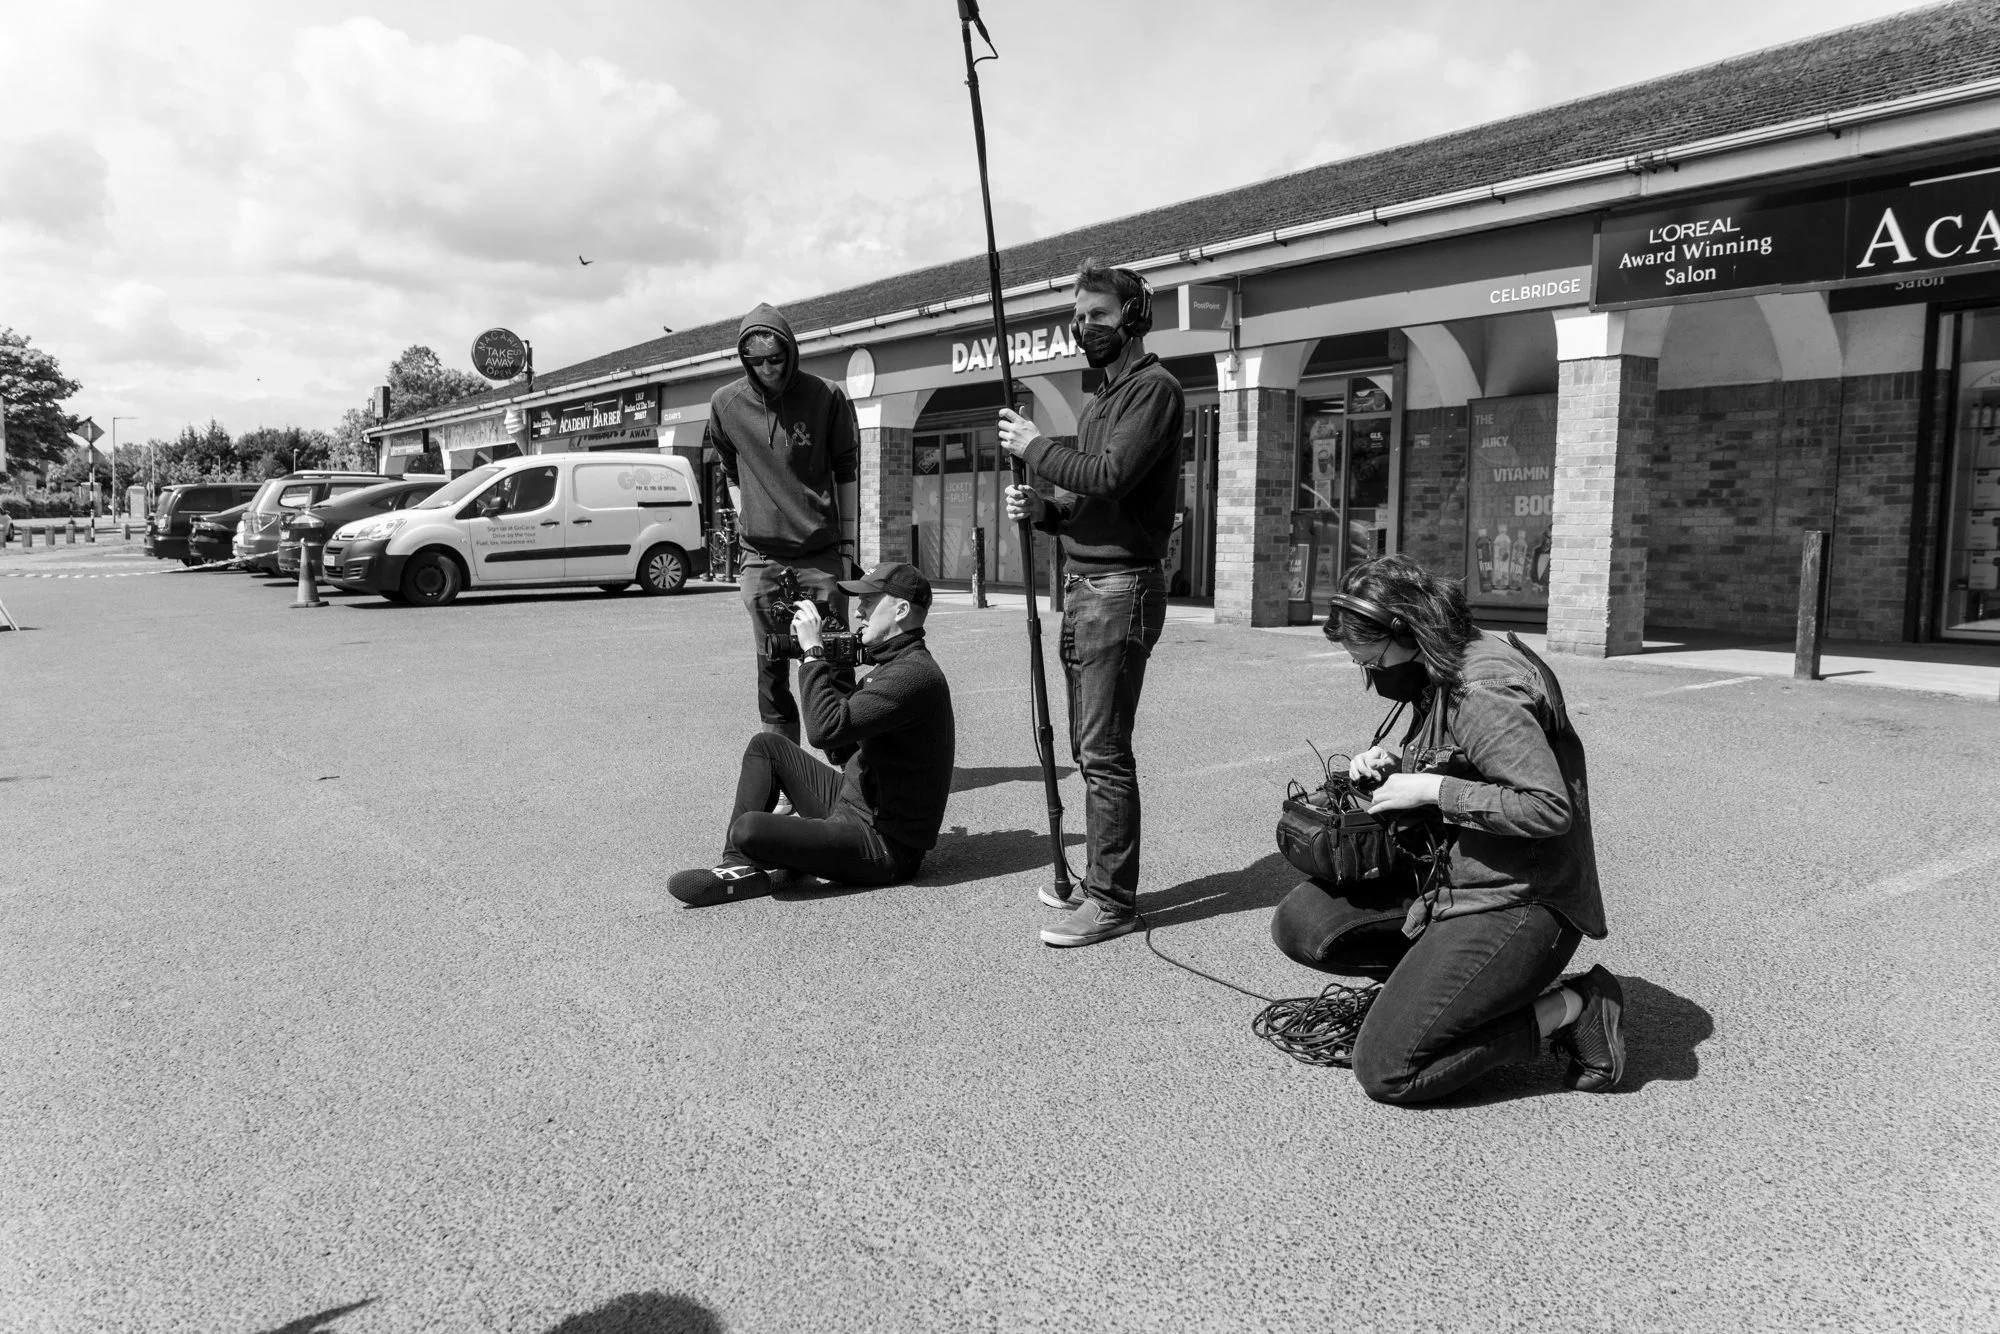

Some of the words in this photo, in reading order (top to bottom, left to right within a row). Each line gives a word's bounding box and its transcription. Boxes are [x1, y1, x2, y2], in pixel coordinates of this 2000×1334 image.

[1649, 216, 1740, 243] L'OREAL
[1856, 207, 2000, 268] ACA
[1618, 245, 1676, 269] Award
[1682, 235, 1773, 260] Winning
[1664, 265, 1717, 286] Salon
[1489, 278, 1581, 304] CELBRIDGE
[1193, 301, 1220, 310] PostPoint
[486, 346, 515, 360] TAKE
[485, 357, 515, 368] AWAY
[486, 366, 512, 377] OPEN
[559, 415, 591, 434] ACADEMY
[593, 407, 622, 428] BARBER
[1475, 413, 1494, 426] THE
[630, 428, 650, 439] AWAY
[1481, 435, 1510, 449] JUICY
[1493, 466, 1550, 482] VITAMIN
